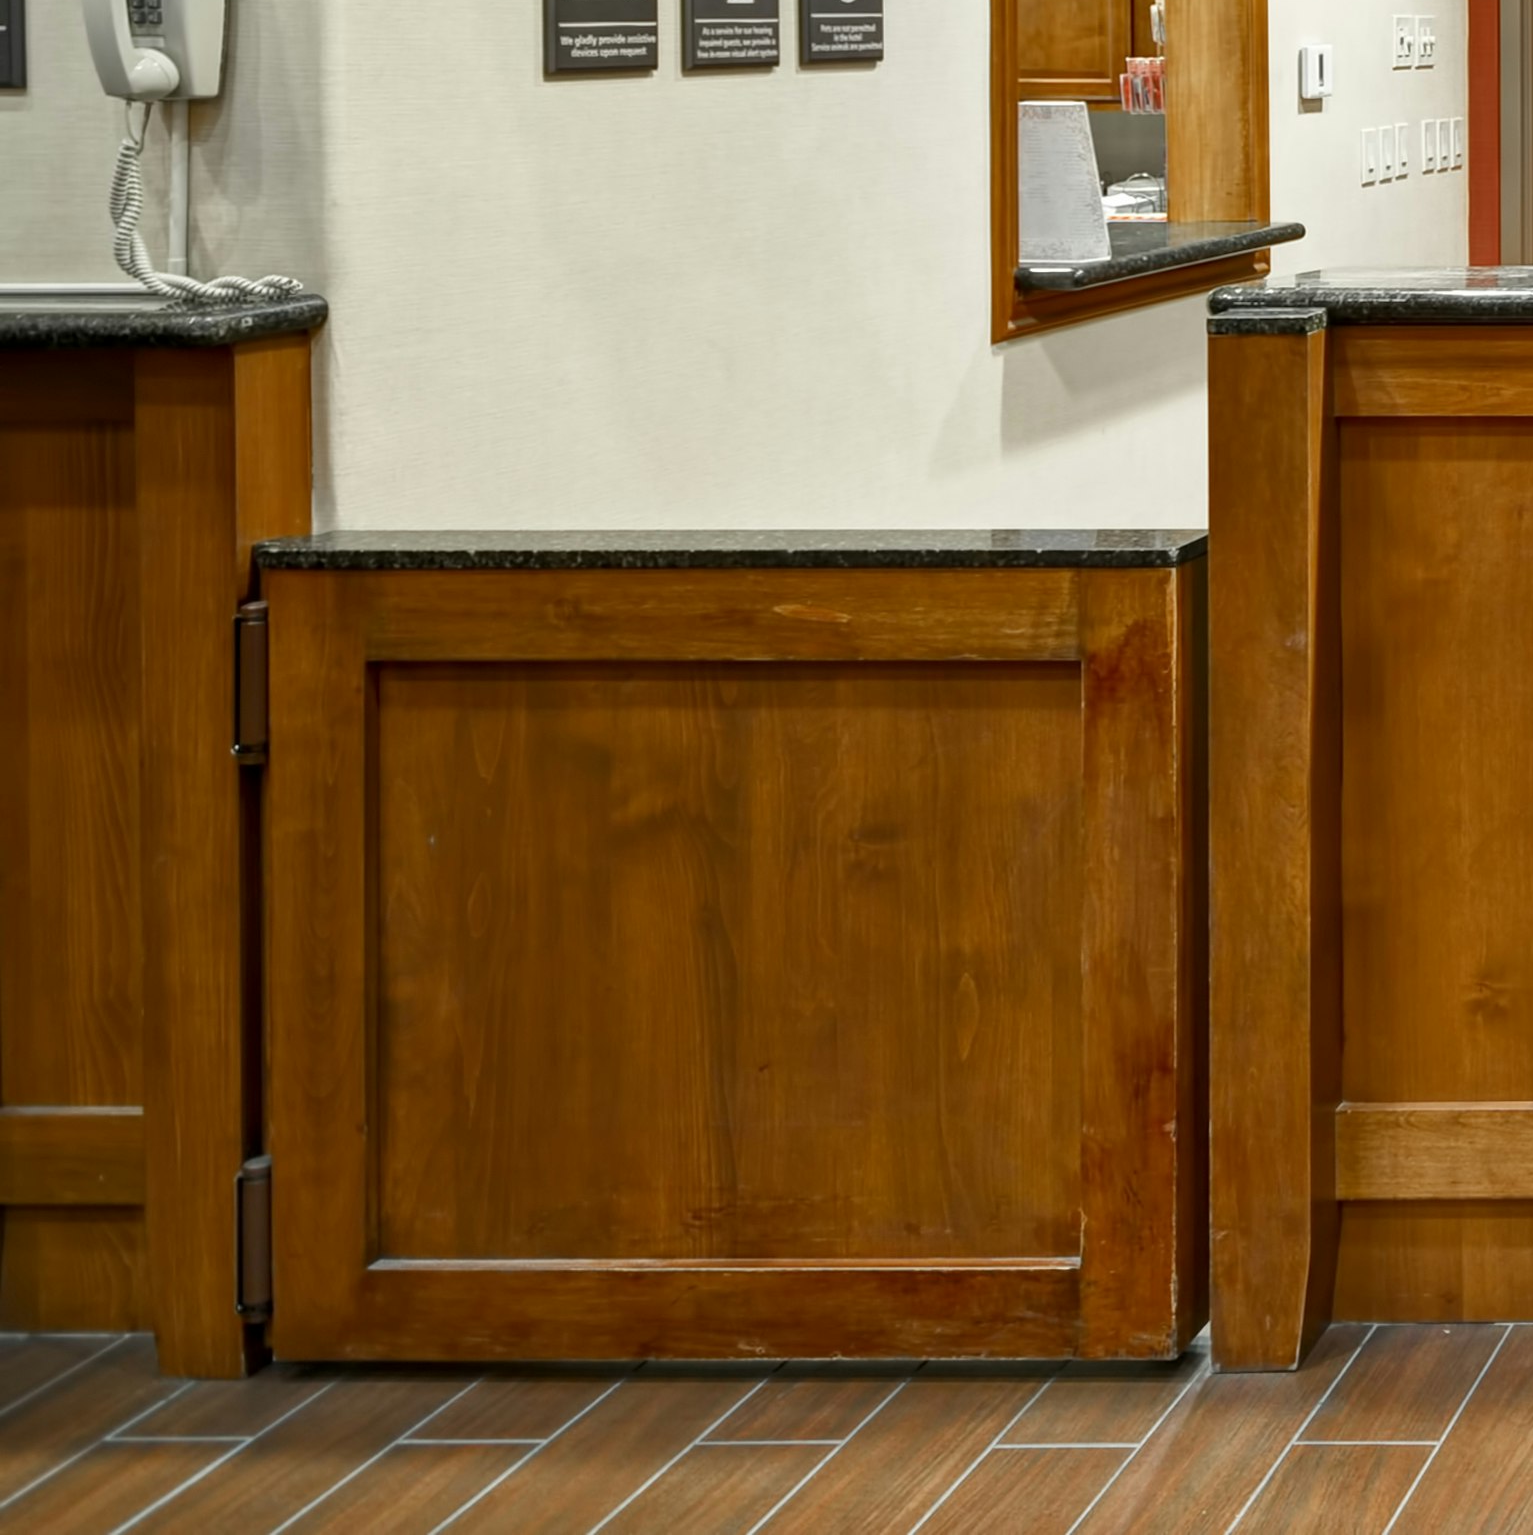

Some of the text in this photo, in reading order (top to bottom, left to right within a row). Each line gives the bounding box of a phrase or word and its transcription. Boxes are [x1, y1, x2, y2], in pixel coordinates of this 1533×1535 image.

[560, 36, 573, 45] We
[574, 34, 597, 47] gladly
[598, 34, 626, 46] provide
[571, 46, 647, 58] devices upon request
